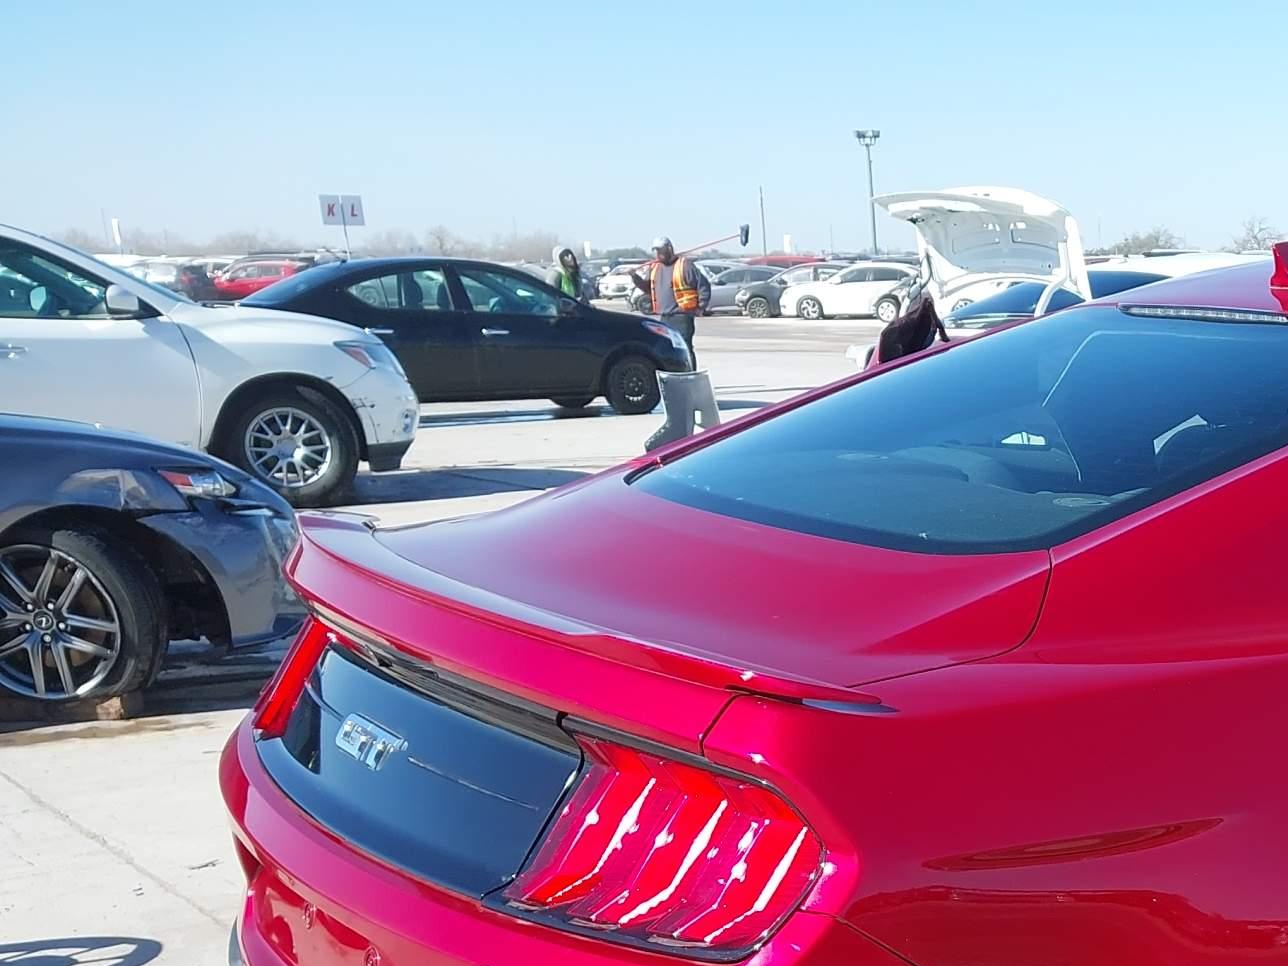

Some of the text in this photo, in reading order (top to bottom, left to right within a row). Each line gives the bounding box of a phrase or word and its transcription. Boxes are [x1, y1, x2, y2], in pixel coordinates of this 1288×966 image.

[327, 203, 358, 217] K L
[335, 710, 409, 771] GT
